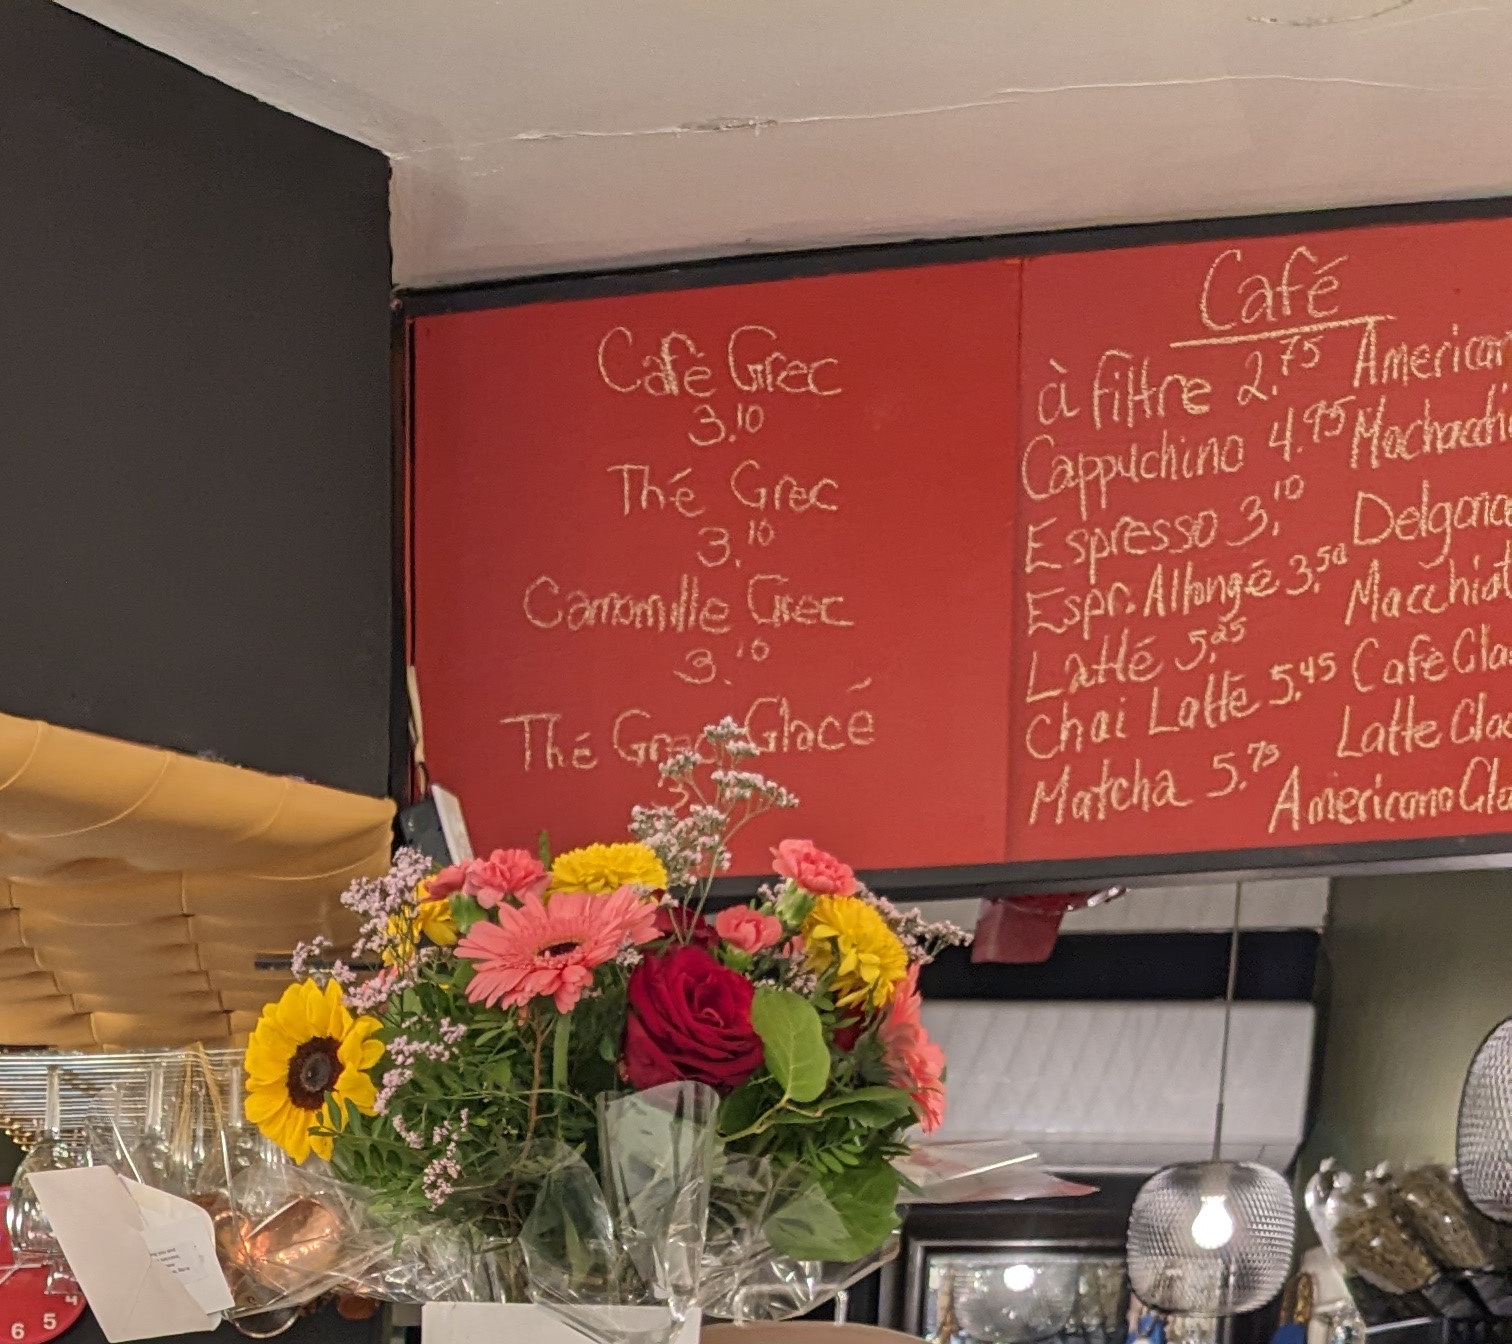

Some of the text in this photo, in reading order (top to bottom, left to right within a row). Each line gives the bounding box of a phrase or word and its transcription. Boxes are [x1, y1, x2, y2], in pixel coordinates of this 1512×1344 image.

[1199, 246, 1349, 332] Café
[727, 325, 843, 396] Grec
[1037, 359, 1080, 426] à
[607, 459, 840, 518] Thé Grec
[1021, 430, 1245, 521] Cappuchino
[1024, 510, 1218, 585] Espresso
[747, 574, 854, 627] Grec
[1143, 558, 1281, 623] Allongé
[499, 712, 599, 772] Thé
[743, 676, 877, 755] Glacé
[1025, 698, 1126, 760] Chai
[1337, 694, 1443, 757] Latte
[1029, 758, 1194, 826] Matcha
[1266, 765, 1455, 834] Americano
[11, 1322, 25, 1340] 6
[43, 1313, 57, 1330] 5
